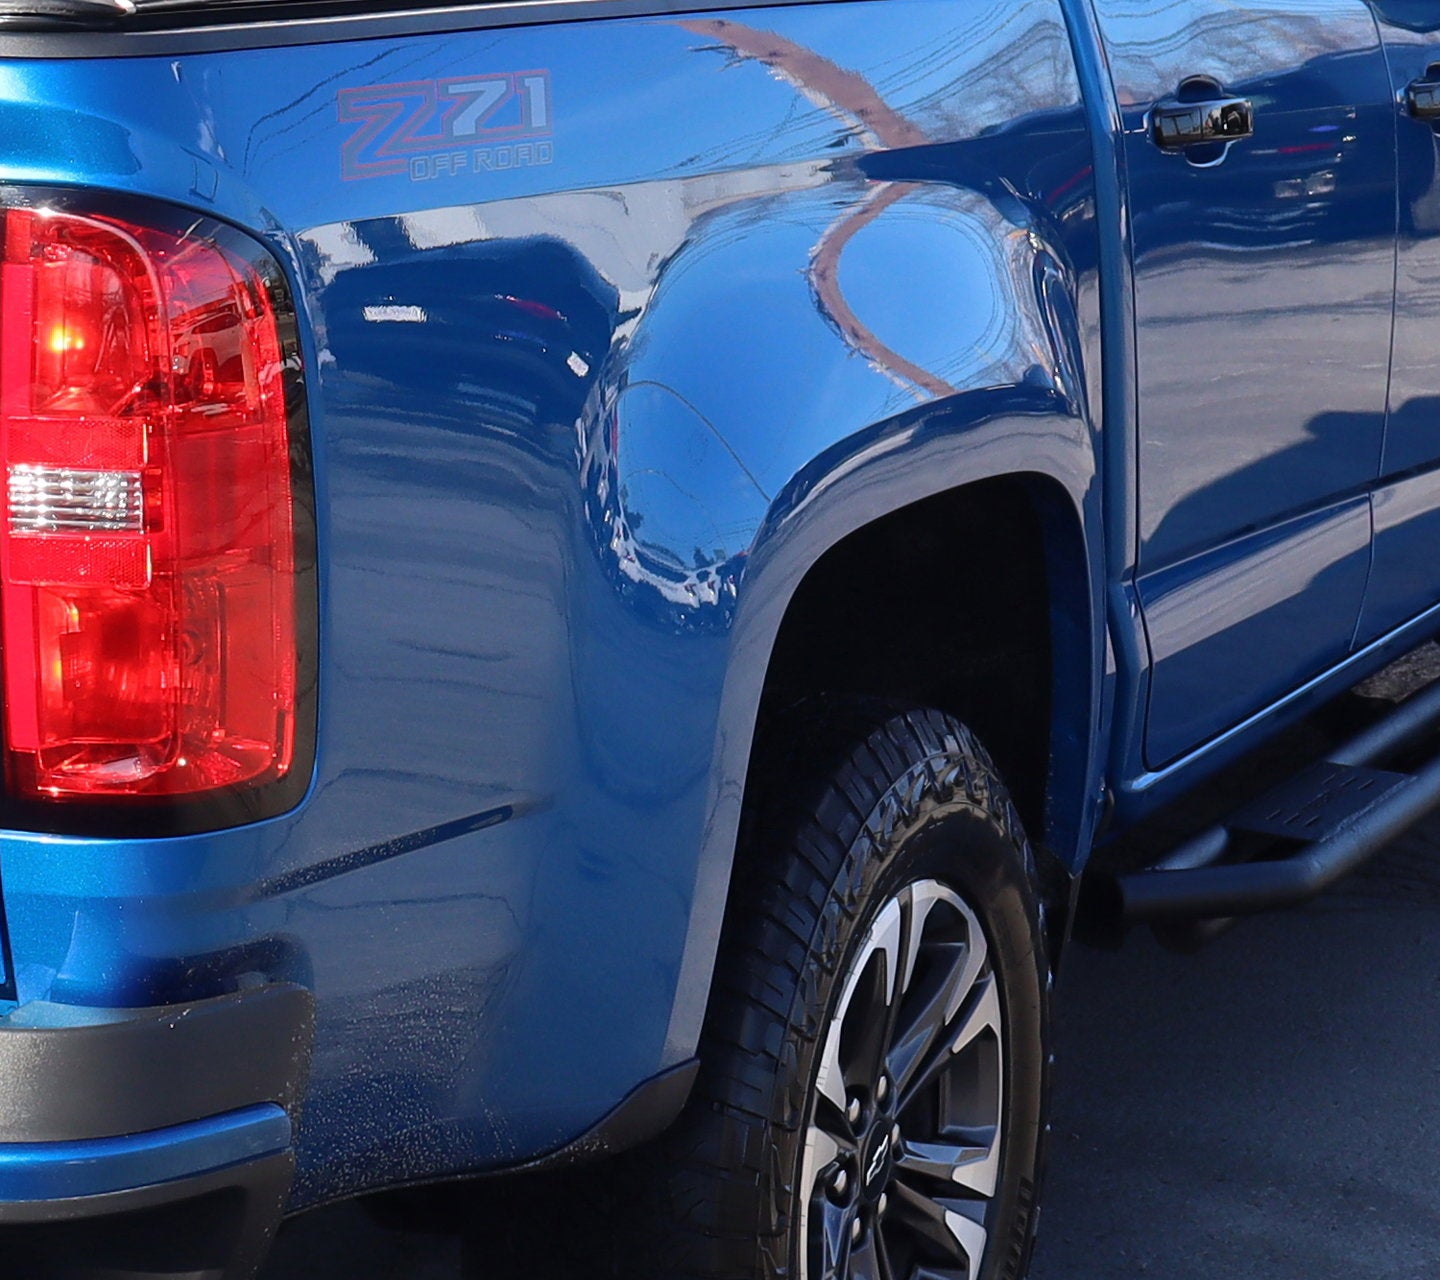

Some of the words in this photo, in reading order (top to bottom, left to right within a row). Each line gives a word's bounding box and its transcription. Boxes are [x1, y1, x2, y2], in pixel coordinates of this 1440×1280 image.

[337, 68, 553, 180] Z71
[408, 151, 468, 182] OFF
[472, 141, 554, 173] ROAD
